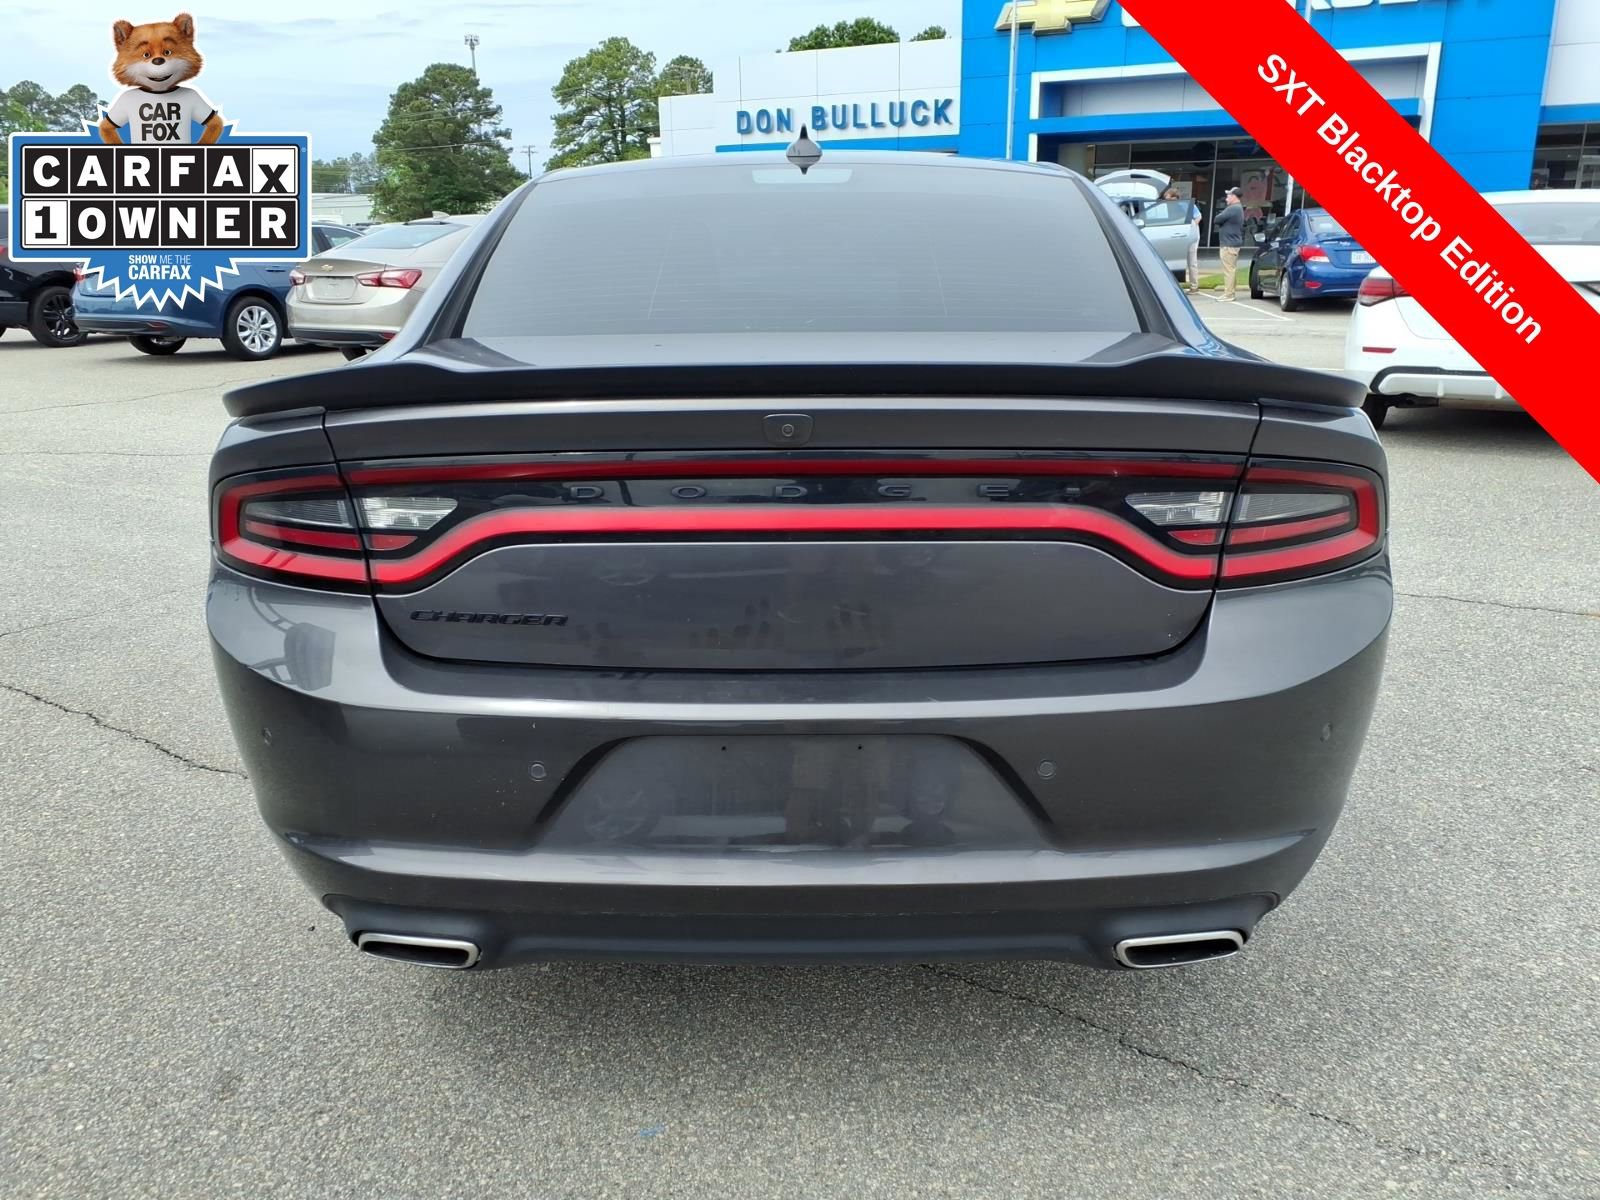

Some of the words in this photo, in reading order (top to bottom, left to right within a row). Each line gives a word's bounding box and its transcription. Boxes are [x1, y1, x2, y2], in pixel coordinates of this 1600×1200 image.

[736, 108, 793, 134] DON
[811, 98, 953, 131] BULLUCK
[569, 483, 1010, 500] DODGE
[409, 609, 570, 627] CHARGER
